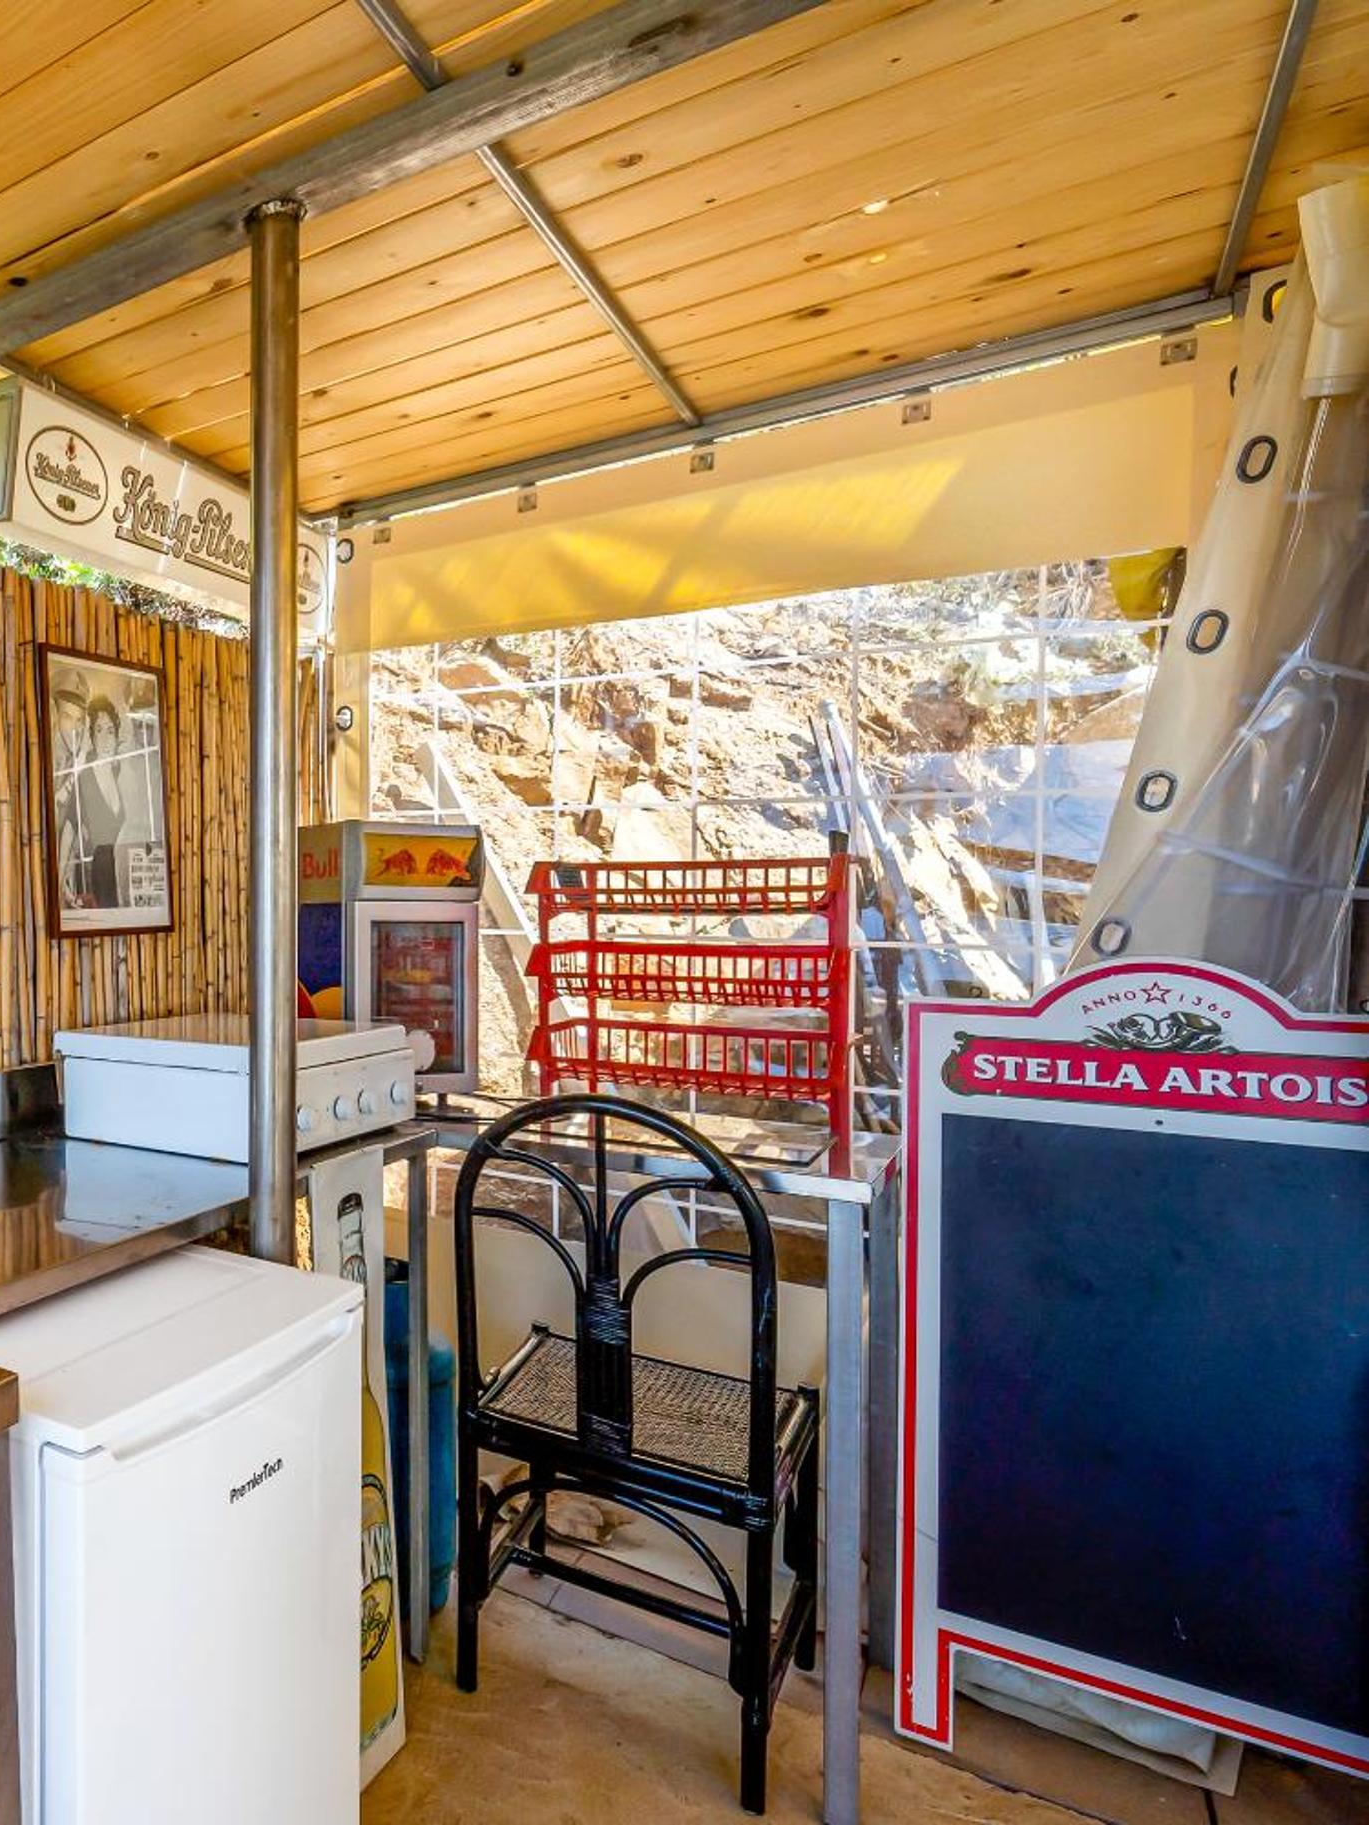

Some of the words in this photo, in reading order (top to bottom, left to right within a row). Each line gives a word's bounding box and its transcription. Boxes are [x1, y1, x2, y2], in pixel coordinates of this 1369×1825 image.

[113, 465, 251, 571] König-Pilse
[302, 847, 339, 880] Bull
[1081, 990, 1137, 1015] ANNO
[973, 1053, 1149, 1092] STELLA
[1158, 1067, 1369, 1108] ARTOIS
